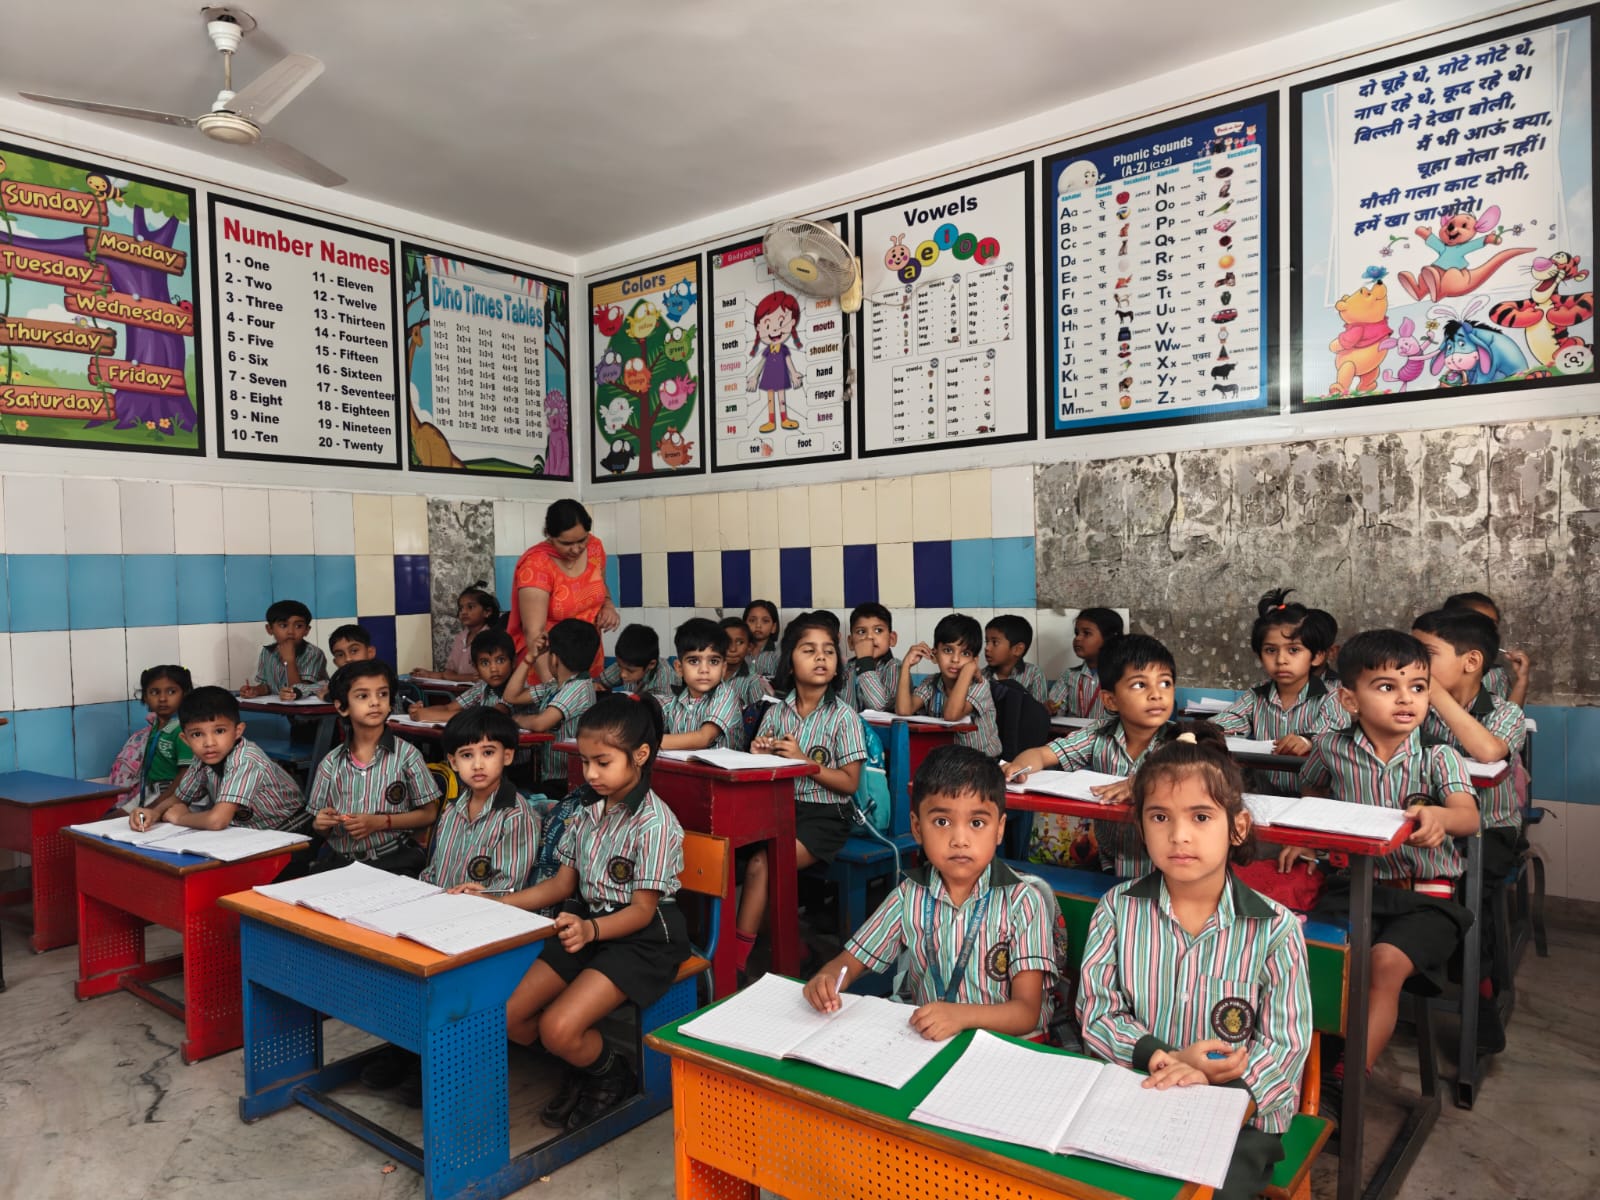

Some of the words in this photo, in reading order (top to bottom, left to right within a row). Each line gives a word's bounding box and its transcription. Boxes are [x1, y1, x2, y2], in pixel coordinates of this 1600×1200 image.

[1358, 79, 1376, 97] दो
[1381, 71, 1407, 96] चूहे
[1412, 66, 1430, 83] थे,
[1437, 54, 1471, 76] मोटे
[1475, 44, 1510, 66] मोटे
[1515, 37, 1535, 56] थे,
[1354, 102, 1387, 120] नाच
[1391, 93, 1413, 113] रहे
[1418, 88, 1436, 105] थे,
[1442, 80, 1475, 103] कूद
[1478, 70, 1502, 91] रहे
[1508, 64, 1532, 82] थे।
[1354, 118, 1403, 144] बिल्ली
[1408, 114, 1422, 130] ने
[1426, 110, 1464, 126] देखा
[1468, 91, 1516, 116] बोली,
[1416, 134, 1432, 151] मैं
[1437, 128, 1460, 147] भी
[1464, 118, 1508, 141] आऊं
[1513, 111, 1553, 130] क्या,
[1113, 148, 1149, 167] Phonic
[1152, 136, 1193, 156] Sounds
[1417, 157, 1451, 180] चूहा
[1455, 146, 1499, 167] बोला
[1503, 134, 1547, 157] नहीं।
[1121, 161, 1147, 178] (A-Z)
[1150, 157, 1172, 170] (a-z)
[1360, 187, 1401, 210] मौसी
[1404, 182, 1440, 201] गला
[1444, 174, 1481, 193] काट
[1485, 161, 1529, 185] दोगी,
[5, 183, 94, 217] Sunday
[904, 196, 978, 227] Vowels
[1354, 215, 1382, 236] हमें
[1384, 212, 1409, 227] खा
[101, 233, 178, 266] Monday
[224, 217, 313, 257] Number
[321, 240, 390, 275] Names
[728, 252, 743, 262] Body
[744, 247, 760, 260] parts
[904, 264, 915, 279] a
[921, 246, 933, 260] e
[944, 229, 950, 244] i
[960, 239, 971, 253] o
[981, 243, 994, 258] u
[3, 251, 94, 283] Tuesday
[225, 252, 231, 263] 1
[245, 257, 270, 271] One
[225, 272, 233, 283] 2
[245, 276, 272, 290] Two
[312, 272, 325, 283] 11
[337, 277, 373, 293] Eleven
[622, 274, 666, 295] Colors
[226, 292, 234, 302] 3
[246, 296, 283, 311] Three
[313, 290, 327, 301] 12
[338, 294, 377, 311] Twelve
[432, 277, 462, 311] Dino
[463, 284, 503, 319] Times
[504, 294, 543, 328] Tables
[722, 298, 736, 307] head
[816, 299, 832, 309] nose
[76, 294, 189, 329] Wednesday
[227, 312, 234, 322] 4
[247, 315, 275, 329] Four
[314, 309, 328, 320] 13
[338, 313, 385, 330] Thirteen
[6, 323, 101, 349] Thursday
[813, 321, 834, 332] mouth
[228, 331, 235, 342] 5
[248, 334, 273, 348] Five
[315, 327, 328, 338] 14
[339, 331, 388, 348] Fourteen
[722, 340, 738, 350] tooth
[228, 351, 236, 362] 6
[248, 354, 268, 366] Six
[315, 345, 329, 356] 15
[340, 349, 378, 364] Fifteen
[669, 346, 684, 355] green
[810, 343, 838, 355] shoulder
[316, 364, 330, 374] 16
[341, 367, 382, 382] Sixteen
[720, 362, 741, 372] tongue
[816, 366, 832, 376] hand
[108, 366, 172, 388] Friday
[229, 370, 237, 381] 7
[249, 373, 287, 388] Seven
[317, 382, 330, 392] 17
[815, 389, 835, 400] finger
[3, 392, 104, 413] Saturday
[230, 390, 238, 401] 8
[250, 392, 282, 406] Eight
[230, 410, 238, 420] 9
[251, 412, 279, 424] Nine
[318, 400, 331, 411] 18
[342, 403, 390, 417] Eighteen
[818, 412, 833, 422] knee
[232, 429, 247, 440] 10
[318, 419, 332, 429] 19
[343, 421, 391, 435] Nineteen
[727, 426, 736, 434] leg
[319, 437, 332, 447] 20
[343, 439, 383, 454] Twenty
[798, 439, 812, 448] foot
